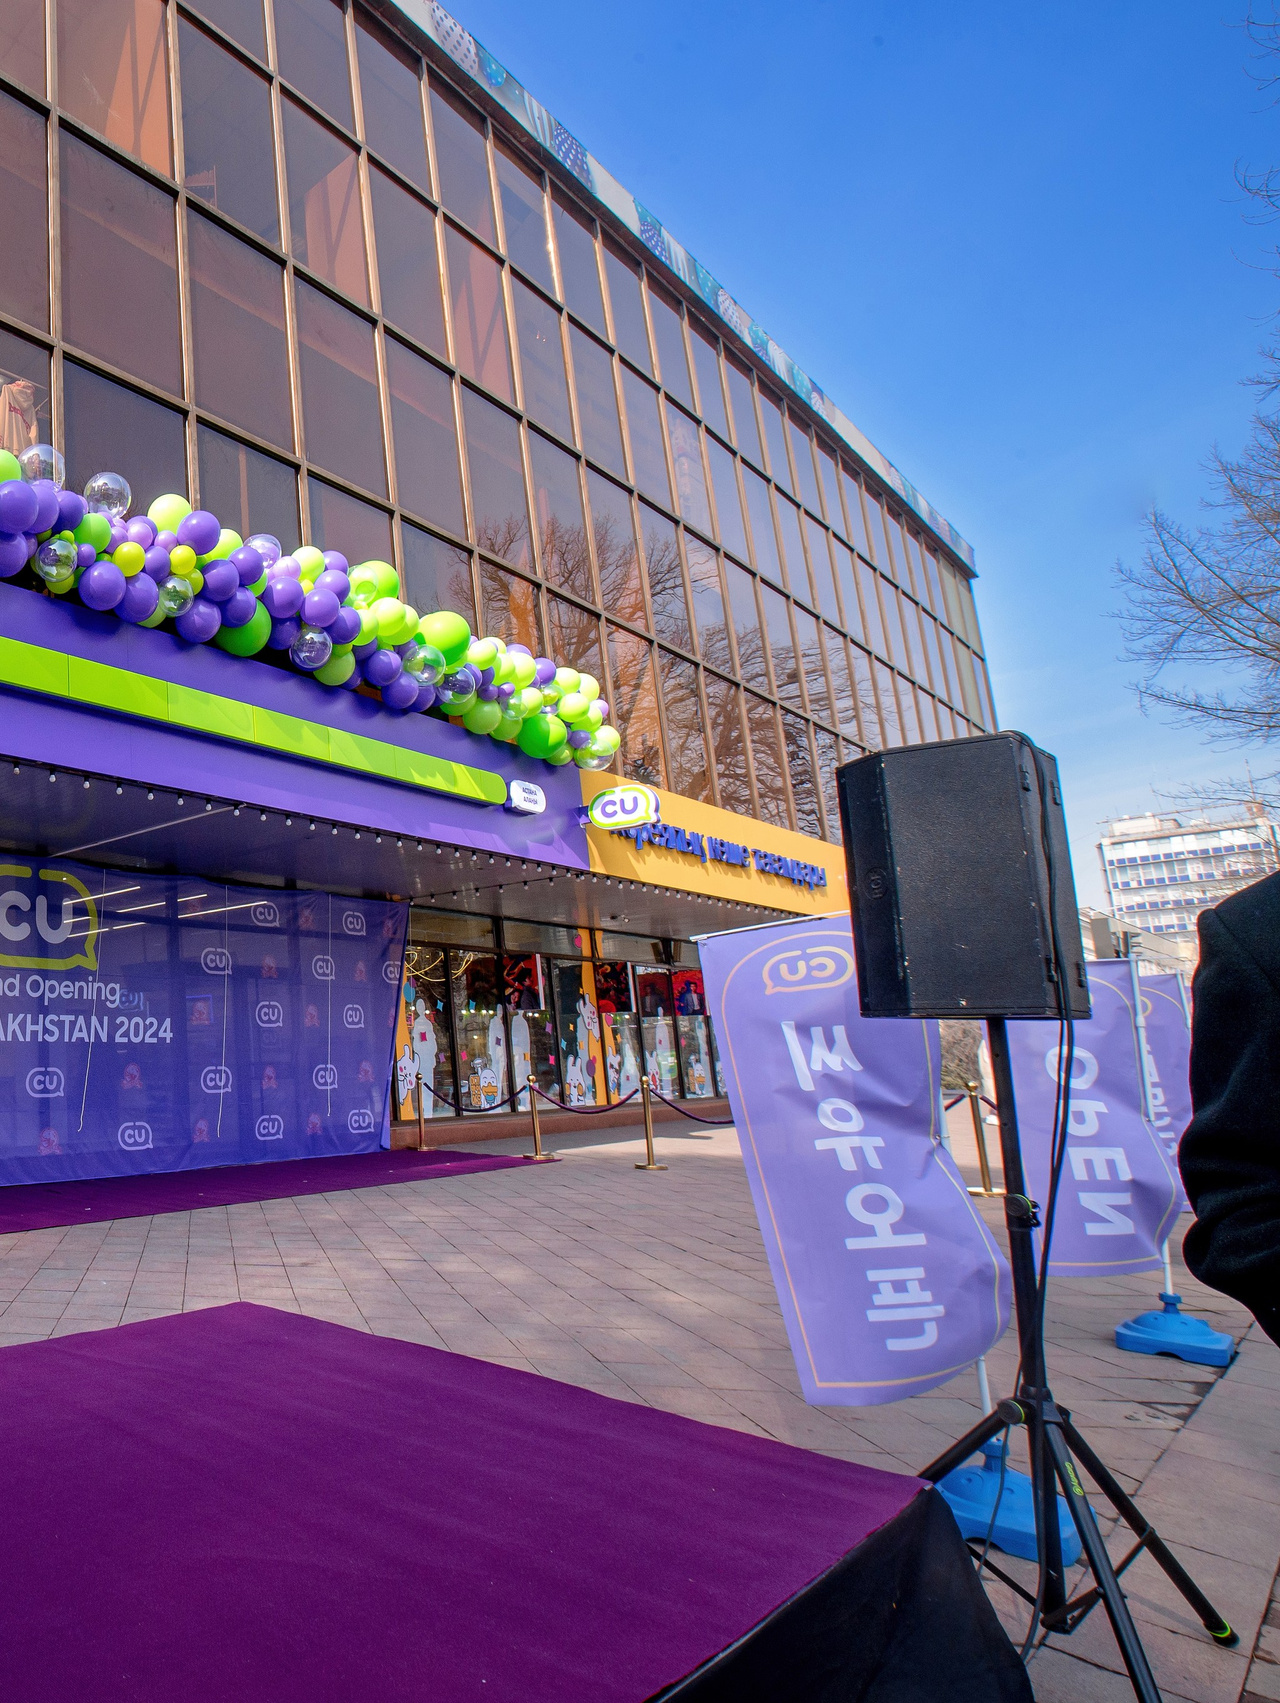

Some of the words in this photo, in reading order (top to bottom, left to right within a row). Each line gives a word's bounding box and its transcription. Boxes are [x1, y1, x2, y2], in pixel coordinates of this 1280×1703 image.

[601, 796, 638, 818] CU
[207, 954, 225, 967] CU
[26, 974, 120, 1008] Opening
[115, 1016, 173, 1043] 2024
[33, 1075, 57, 1090] CU
[207, 1073, 226, 1086] CU
[125, 1129, 145, 1143] CU
